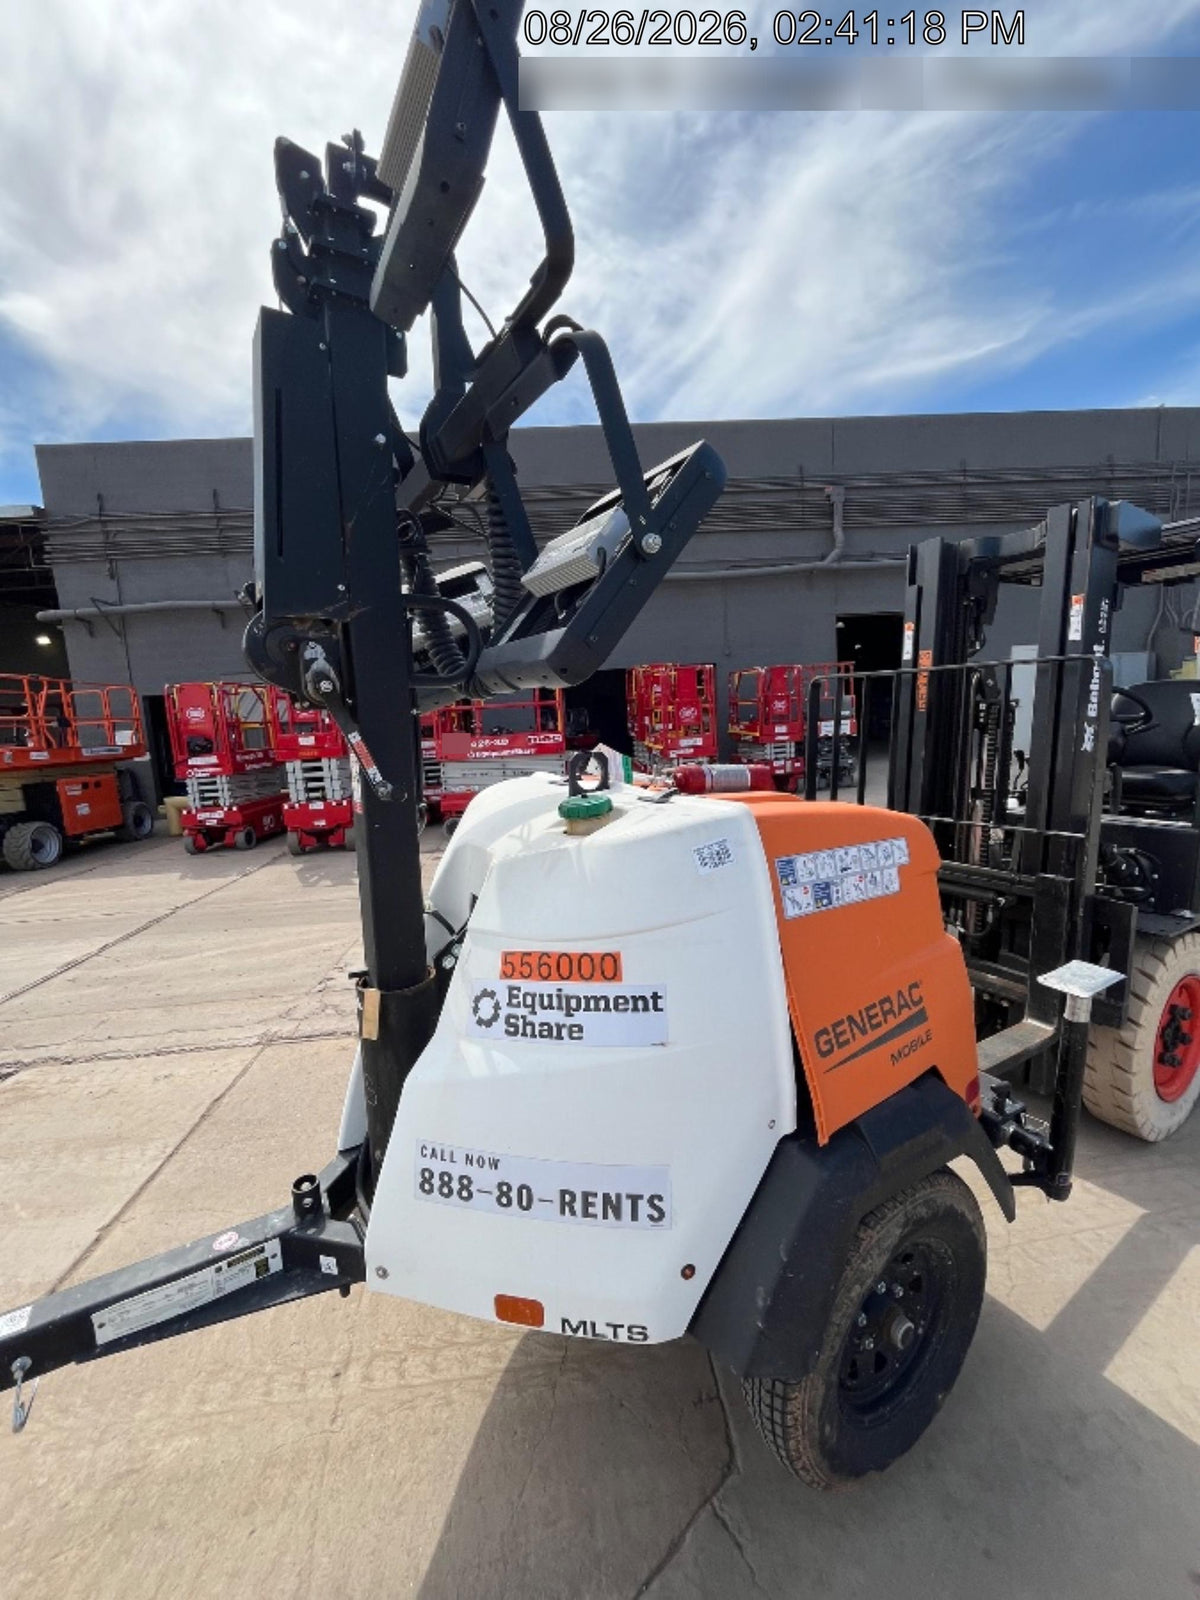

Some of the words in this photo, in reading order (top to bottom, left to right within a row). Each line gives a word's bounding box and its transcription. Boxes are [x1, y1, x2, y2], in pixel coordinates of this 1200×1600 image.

[502, 952, 618, 981] 556000
[506, 985, 664, 1017] Equipment
[504, 1014, 584, 1040] Share
[814, 981, 924, 1058] GENERAC
[890, 1029, 932, 1066] MOBILE
[420, 1144, 457, 1163] CALL
[465, 1153, 500, 1171] NOW
[419, 1167, 666, 1223] 888-80-RENTS
[560, 1317, 649, 1342] MLTS
